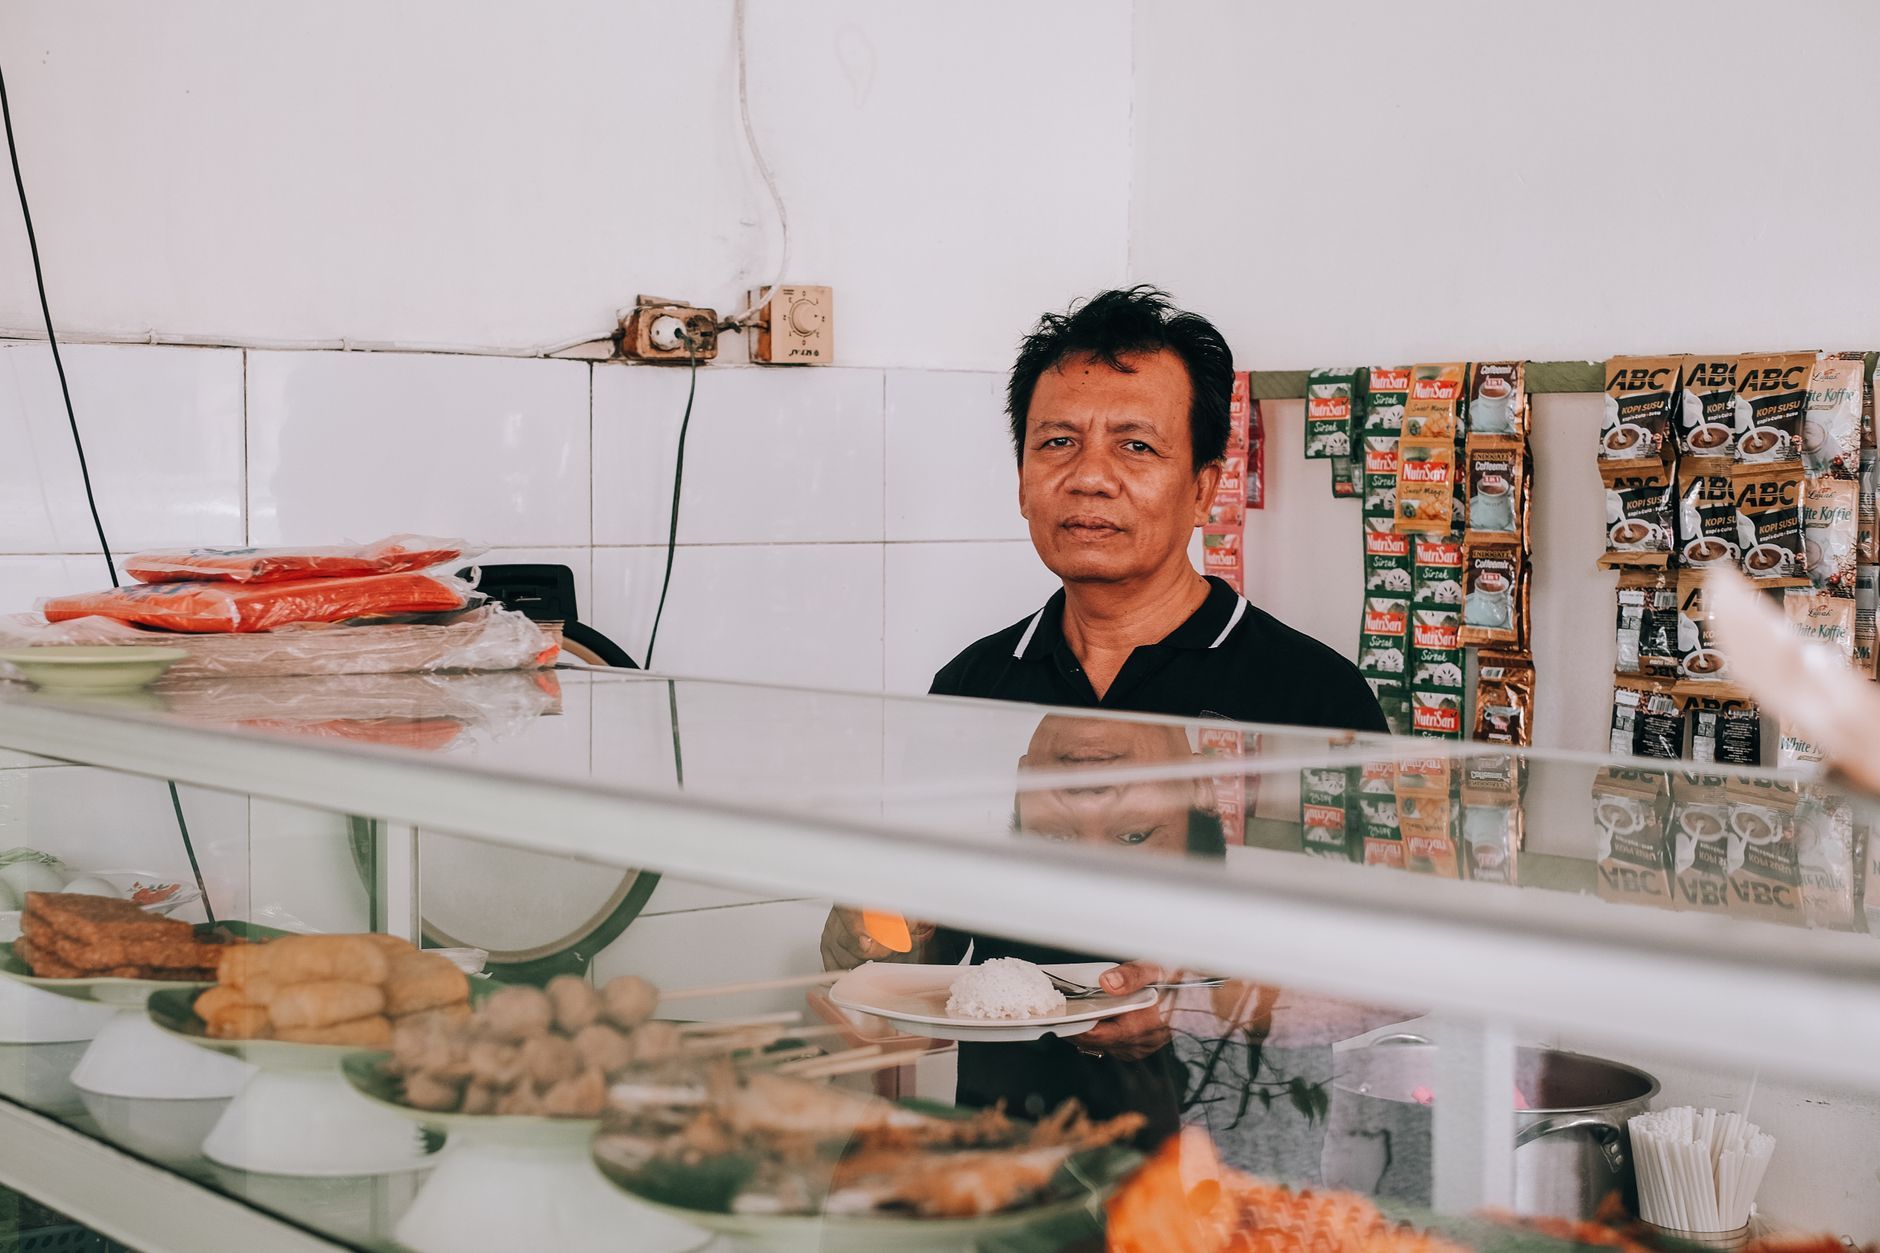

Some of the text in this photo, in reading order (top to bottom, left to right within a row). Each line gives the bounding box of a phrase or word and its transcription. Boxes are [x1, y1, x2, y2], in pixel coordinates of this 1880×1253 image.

[1370, 372, 1409, 389] NutriSari
[1606, 368, 1671, 391] ABC
[1737, 366, 1805, 392] ABC
[1413, 382, 1455, 399] NutriSari
[1309, 400, 1347, 417] NutriSari
[1621, 401, 1665, 415] KOPI SUSU
[1706, 404, 1725, 414] KOPI
[1756, 405, 1777, 417] KOPI
[1778, 401, 1801, 413] SUSU
[1366, 453, 1397, 471] NutriSa
[1403, 463, 1448, 481] NutriSari
[1736, 480, 1797, 508] ABC
[1626, 499, 1646, 510] KOPI
[1705, 517, 1726, 527] KOPI
[1759, 524, 1779, 535] KOPI
[1779, 517, 1798, 530] SUSU
[1367, 535, 1405, 552] NutriSari
[1373, 556, 1397, 567] Sirsak
[1416, 545, 1457, 563] NutriSari
[1422, 568, 1449, 579] Sirsak
[1365, 614, 1402, 632] NutriSari
[1369, 635, 1393, 647] Sirsak
[1414, 627, 1456, 646] NutriSari
[1818, 624, 1847, 641] Koffie
[1421, 649, 1447, 661] Sirsak
[1414, 708, 1456, 729] NutriSari
